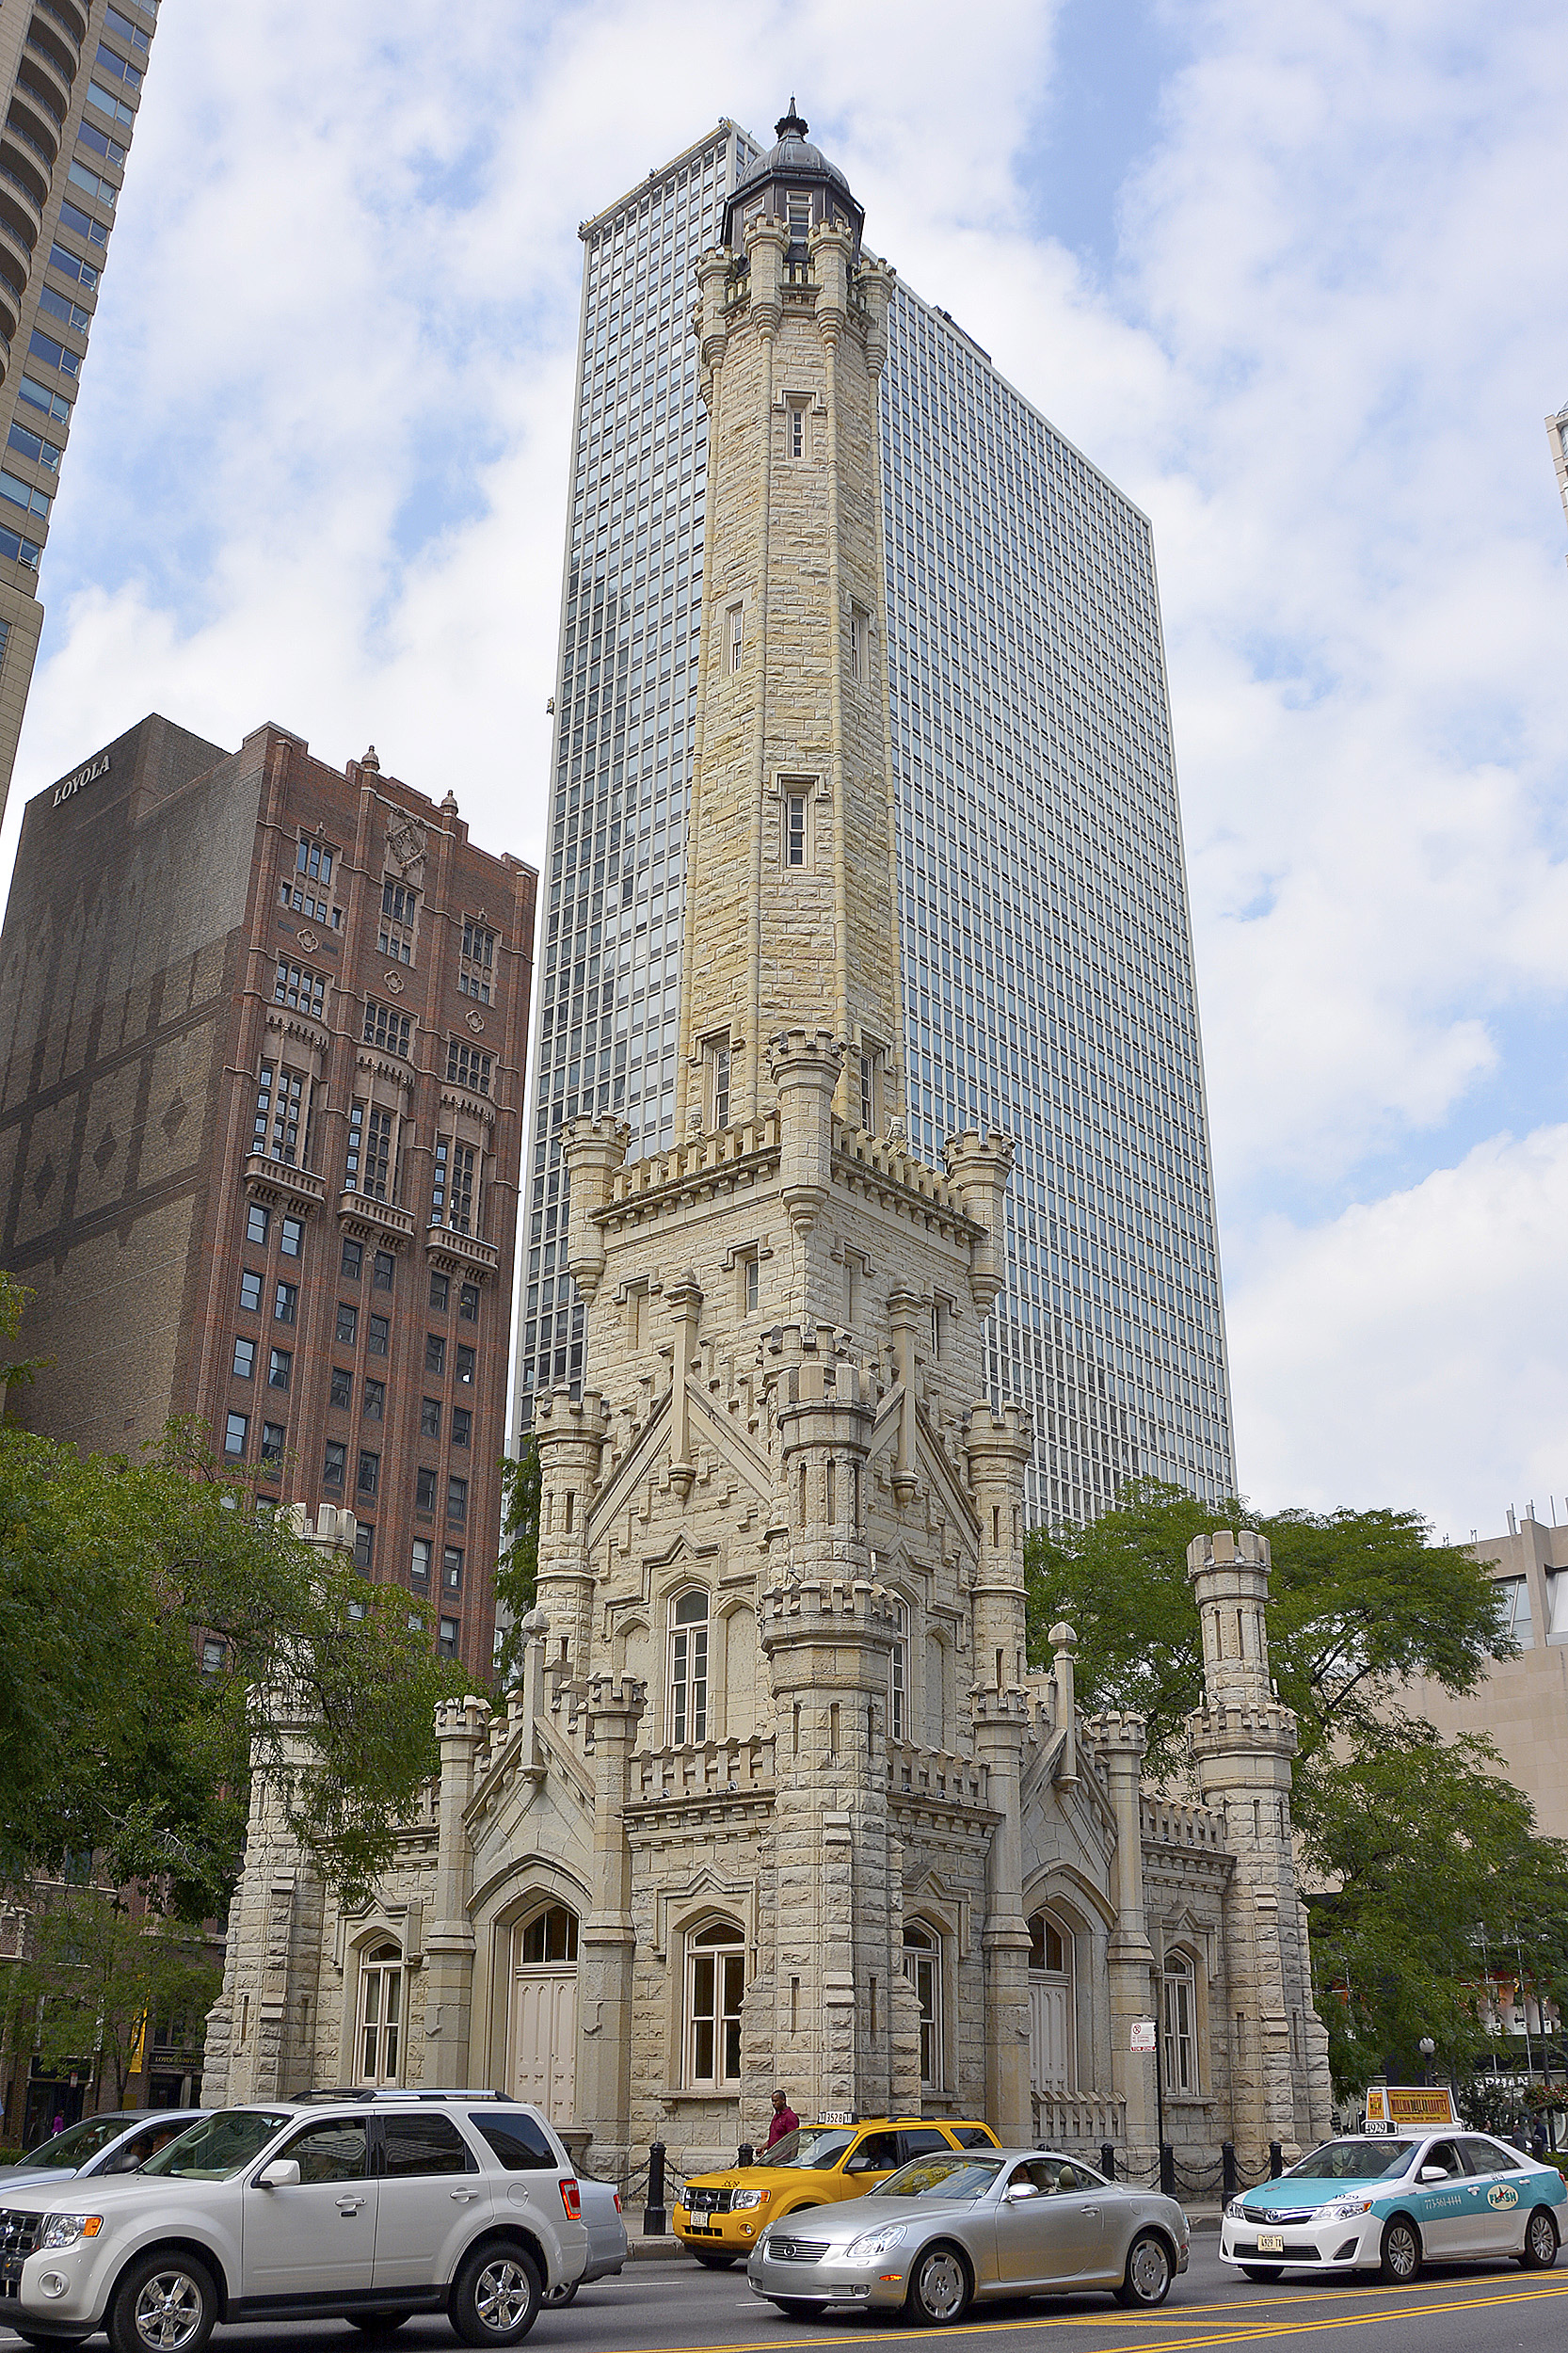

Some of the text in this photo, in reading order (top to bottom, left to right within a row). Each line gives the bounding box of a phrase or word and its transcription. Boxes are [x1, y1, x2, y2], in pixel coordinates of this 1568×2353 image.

[52, 755, 110, 808] LOYOLA
[1391, 2099, 1411, 2112] MILLION
[826, 2112, 842, 2122] 3528
[1366, 2121, 1386, 2134] 4929
[1489, 2185, 1517, 2204] FLASH
[1424, 2195, 1463, 2210] 773-561-4444
